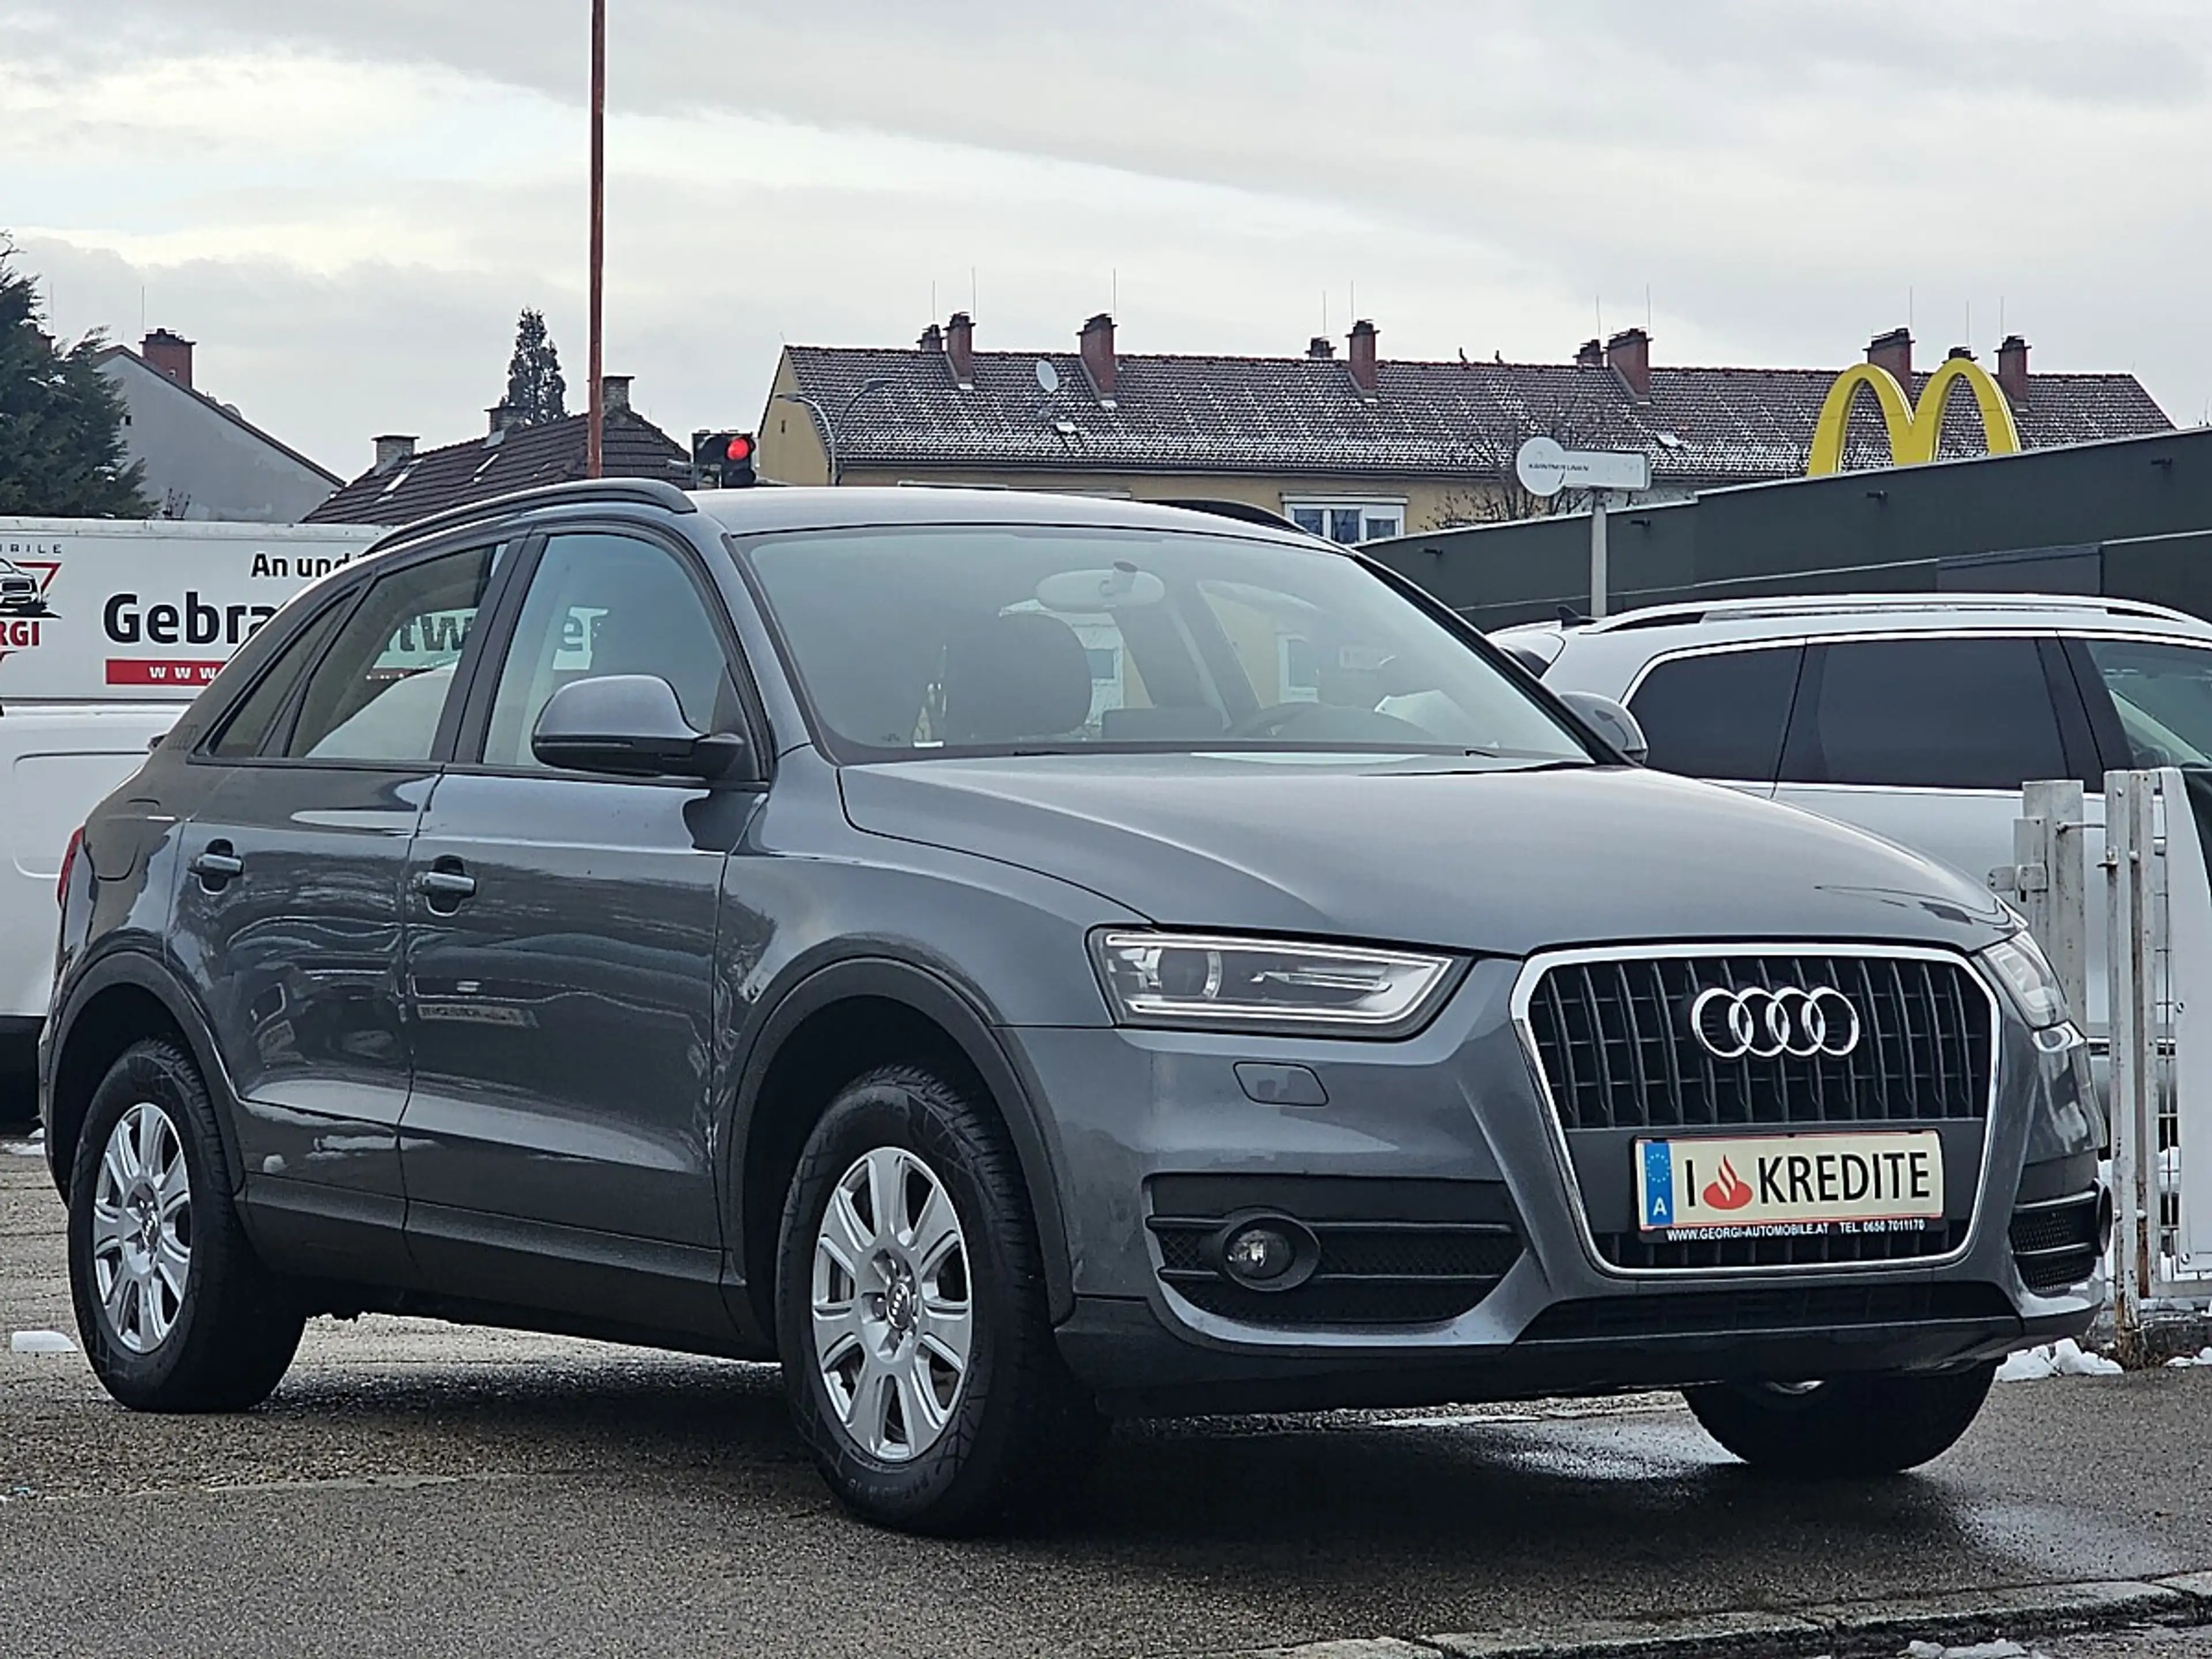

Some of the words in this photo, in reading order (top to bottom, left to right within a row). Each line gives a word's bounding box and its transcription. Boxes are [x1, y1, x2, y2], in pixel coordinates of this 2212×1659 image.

[0, 543, 62, 554] BILE
[251, 552, 289, 577] An
[1685, 1158, 1696, 1207] I
[1758, 1152, 1931, 1204] KREDITE
[1652, 1196, 1668, 1217] A
[1666, 1222, 1830, 1242] WWW.GEORGI-AUTOMOBILE.AT
